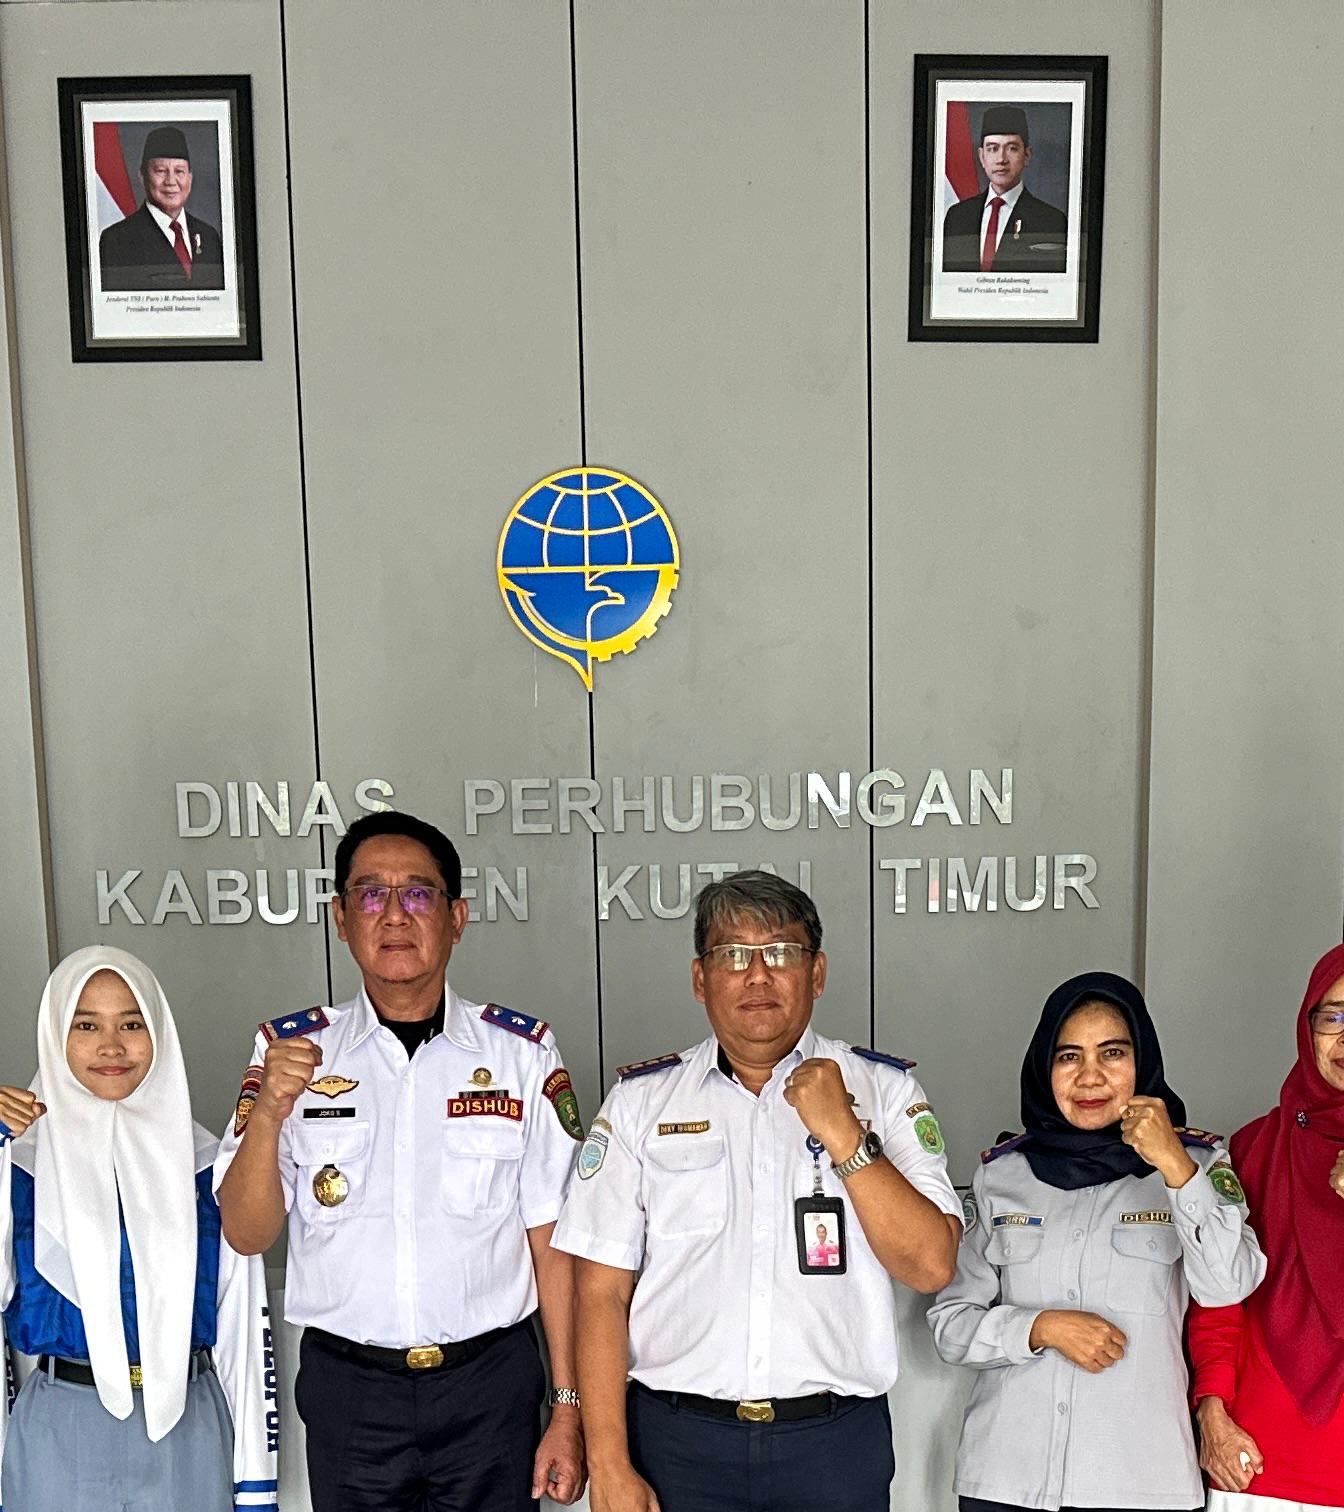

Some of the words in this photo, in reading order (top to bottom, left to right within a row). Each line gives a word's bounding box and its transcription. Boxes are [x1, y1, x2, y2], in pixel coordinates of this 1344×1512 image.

[175, 778, 395, 839] DINAS
[463, 768, 1014, 835] PERHUBUNGAN
[879, 853, 1101, 914] TIMUR
[452, 1100, 519, 1117] DISHUB
